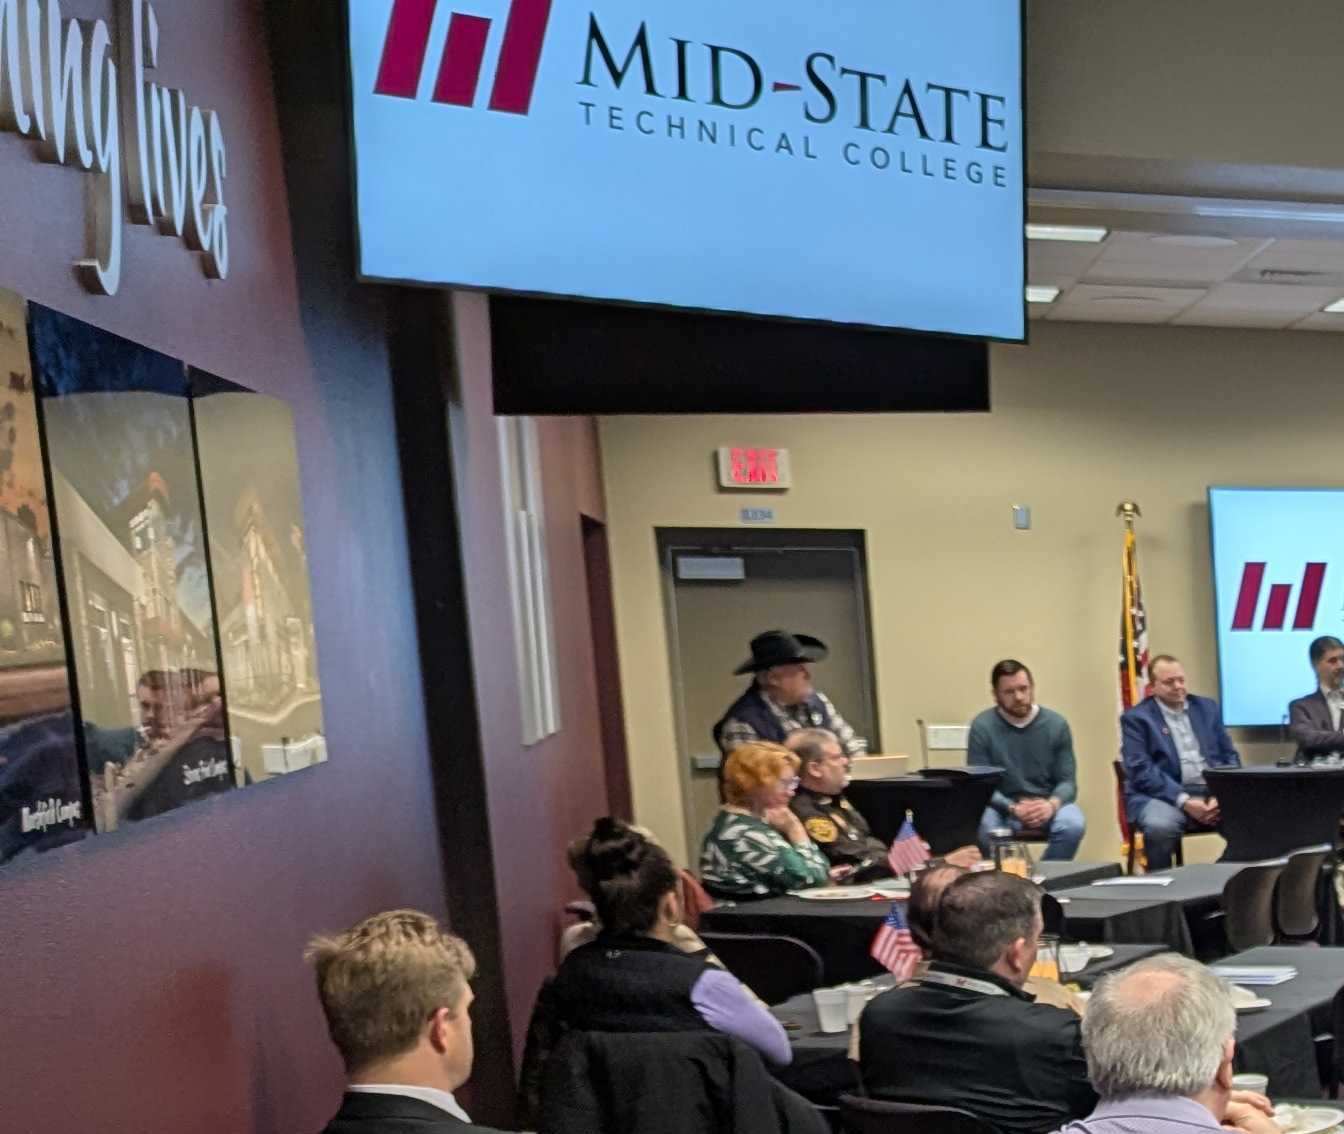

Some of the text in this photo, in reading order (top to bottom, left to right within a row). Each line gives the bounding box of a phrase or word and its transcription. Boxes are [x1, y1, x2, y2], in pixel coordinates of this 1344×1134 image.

[132, 0, 229, 281] lives
[576, 11, 1009, 153] MID-STATE
[578, 101, 1008, 188] TECHNICAL COLLEGE
